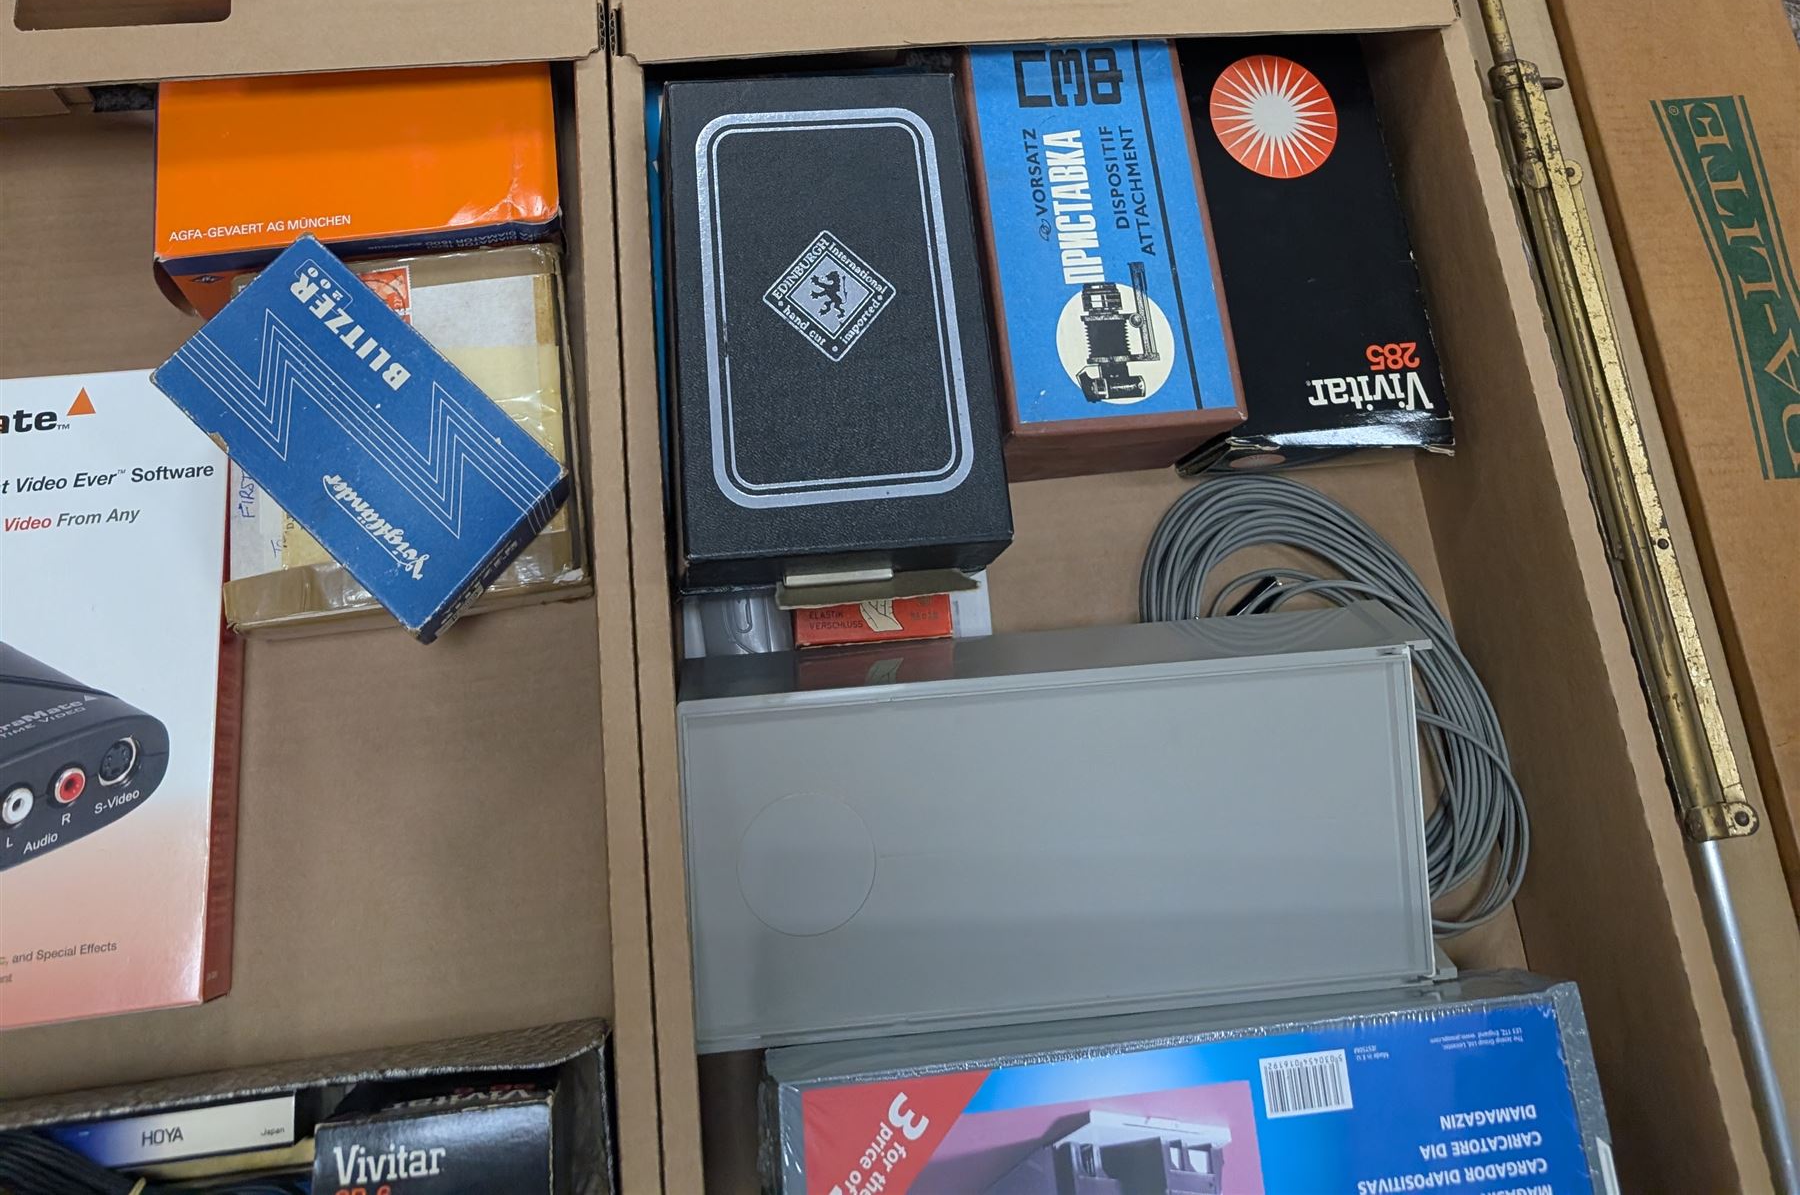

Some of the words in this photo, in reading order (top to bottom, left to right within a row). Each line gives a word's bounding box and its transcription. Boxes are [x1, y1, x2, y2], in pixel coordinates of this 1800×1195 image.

[1030, 127, 1047, 218] VORSATZ
[1098, 124, 1131, 231] DISPOSITIF
[1119, 124, 1157, 257] ATTACHMENT
[1042, 128, 1105, 286] ПРИСТАВКА
[169, 222, 264, 242] AGFA-GEVAERT
[267, 220, 286, 233] AG
[287, 213, 352, 231] MÜNCHEN
[771, 237, 830, 300] EDINBURGH
[827, 241, 888, 295] International
[289, 275, 412, 392] BLITZER
[781, 305, 811, 332] hand
[808, 329, 827, 346] cut
[838, 297, 881, 346] imported
[1366, 342, 1421, 370] 285
[1308, 371, 1435, 412] Vivitar
[16, 475, 68, 494] Video
[130, 464, 215, 483] Software
[4, 515, 52, 533] Video
[56, 511, 102, 528] From
[105, 507, 141, 524] Any
[322, 474, 430, 581] Voigtländer
[0, 699, 84, 732] raMate
[94, 788, 140, 815] S-Video
[6, 837, 14, 849] L
[61, 812, 71, 827] R
[23, 832, 59, 855] Audio
[12, 951, 33, 964] and
[36, 945, 77, 962] Special
[79, 940, 118, 956] Effects
[888, 1092, 930, 1141] 3
[1439, 1104, 1538, 1131] DIAMAGAZIN
[141, 1125, 184, 1148] HOYA
[260, 1125, 285, 1138] Japan
[859, 1121, 894, 1170] price
[1419, 1144, 1448, 1160] DIA
[1450, 1131, 1543, 1157] CARICATORE
[333, 1145, 447, 1186] Vivitar
[881, 1141, 907, 1173] for
[1465, 1157, 1548, 1183] CARGADOR
[1357, 1169, 1460, 1195] DIAPOSITIVAS
